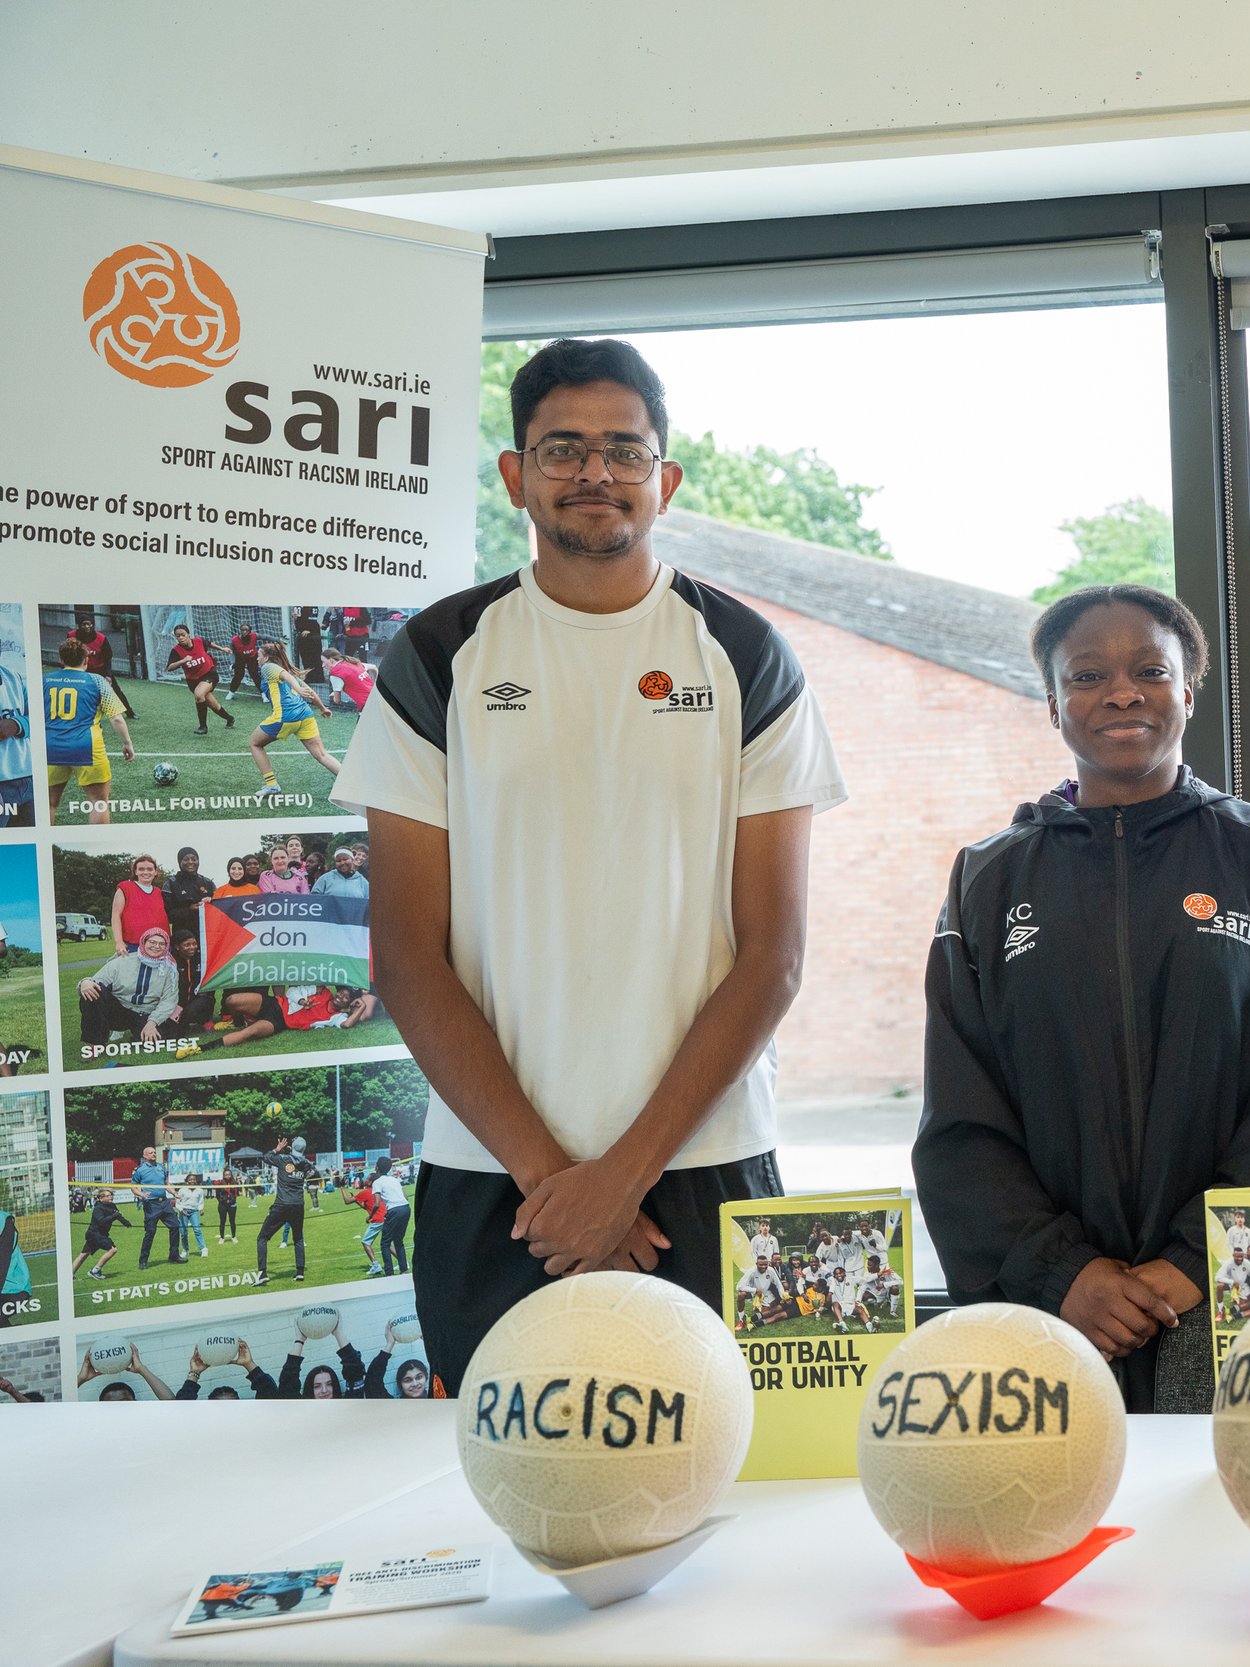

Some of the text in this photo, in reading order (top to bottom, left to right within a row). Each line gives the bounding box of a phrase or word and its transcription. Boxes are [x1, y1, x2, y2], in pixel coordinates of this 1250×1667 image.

[313, 363, 431, 395] www.sari.ie
[225, 380, 431, 467] sari
[161, 445, 429, 495] SPORT AGAINST RACISM IRELAND
[25, 487, 99, 512] power
[105, 493, 128, 514] of
[132, 499, 192, 522] sport
[197, 503, 219, 524] to
[224, 507, 317, 535] embrace
[322, 515, 429, 550] difference,
[0, 521, 427, 580] promote social inclusion across Ireland.
[186, 656, 206, 669] sari
[49, 687, 78, 721] 10
[486, 701, 527, 711] umbro
[668, 691, 713, 707] sari
[0, 802, 18, 816] N
[68, 792, 314, 814] FOOTBALL FOR UNITY (FFU)
[241, 894, 323, 923] Saoirse
[1006, 902, 1033, 929] KC
[259, 925, 307, 948] don
[1005, 941, 1036, 963] umbro
[232, 958, 349, 985] Phalaistín
[80, 1036, 201, 1060] SPORTSFEST
[91, 1287, 116, 1304] ST
[174, 1275, 226, 1295] OPEN
[227, 1269, 264, 1288] DAY
[0, 1298, 41, 1316] CKS
[94, 1345, 127, 1361] SEXISM
[206, 1336, 236, 1346] RACISM
[751, 1363, 868, 1391] OR UNITY
[475, 1377, 685, 1449] RACISM
[872, 1367, 1070, 1439] SEXISM
